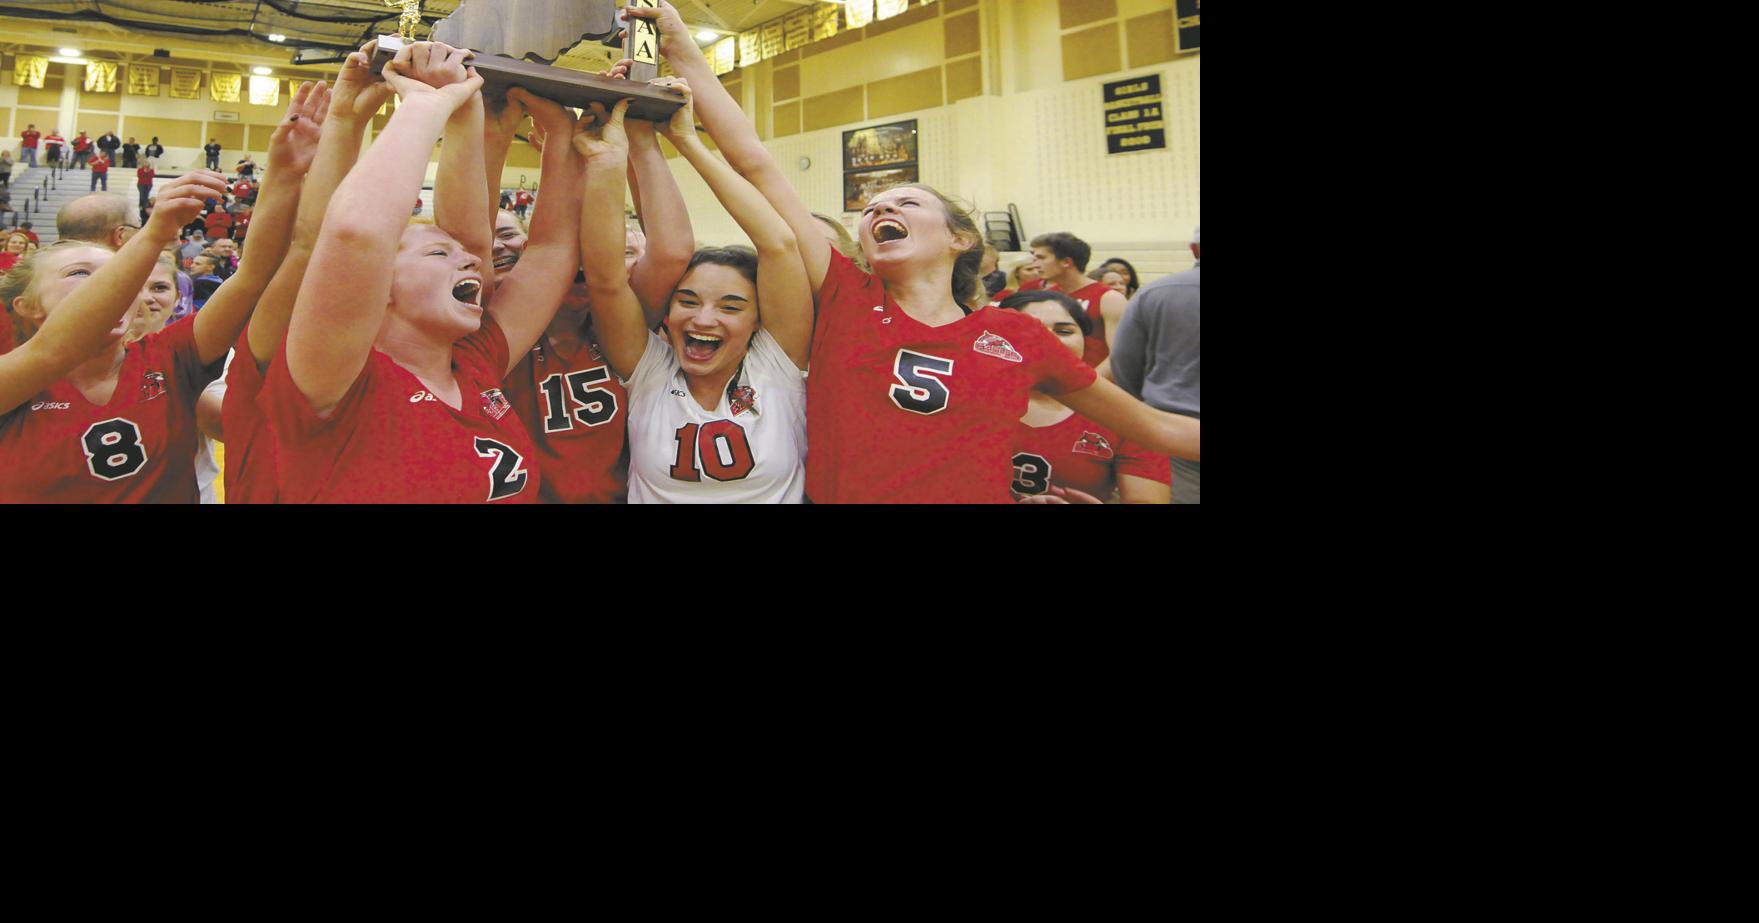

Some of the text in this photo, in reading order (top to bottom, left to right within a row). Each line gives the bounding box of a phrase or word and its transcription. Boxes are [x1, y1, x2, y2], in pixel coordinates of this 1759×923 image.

[539, 365, 618, 434] 15
[889, 348, 955, 415] 5
[81, 417, 149, 482] 8
[474, 436, 528, 502] 2
[670, 418, 755, 483] 10
